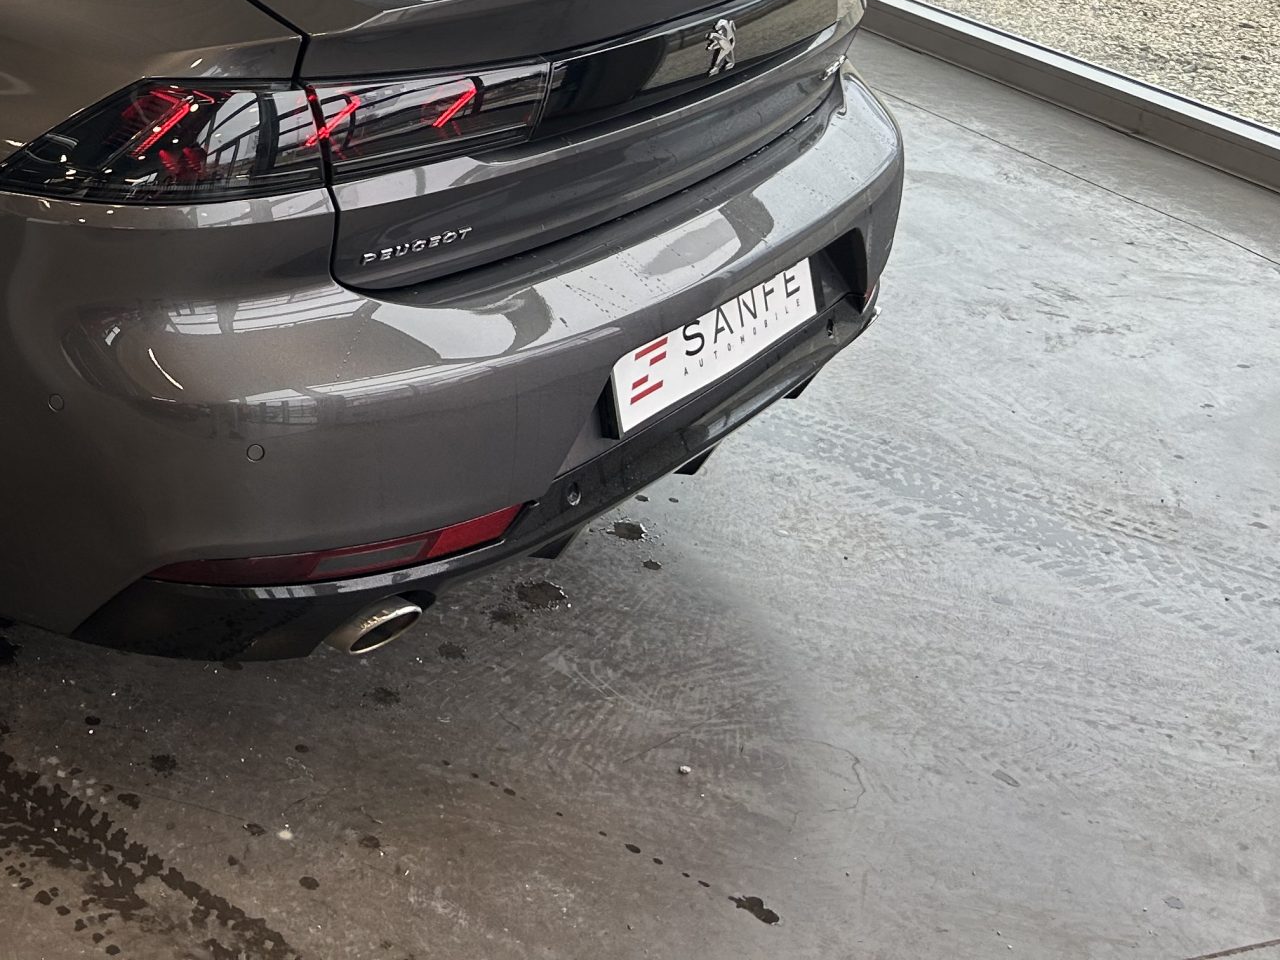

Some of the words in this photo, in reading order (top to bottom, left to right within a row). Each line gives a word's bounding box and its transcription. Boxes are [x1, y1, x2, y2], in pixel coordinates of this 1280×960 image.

[362, 226, 473, 266] PEUGEOT
[682, 271, 800, 357] SANFE
[684, 299, 800, 376] AUTOMOBILE
